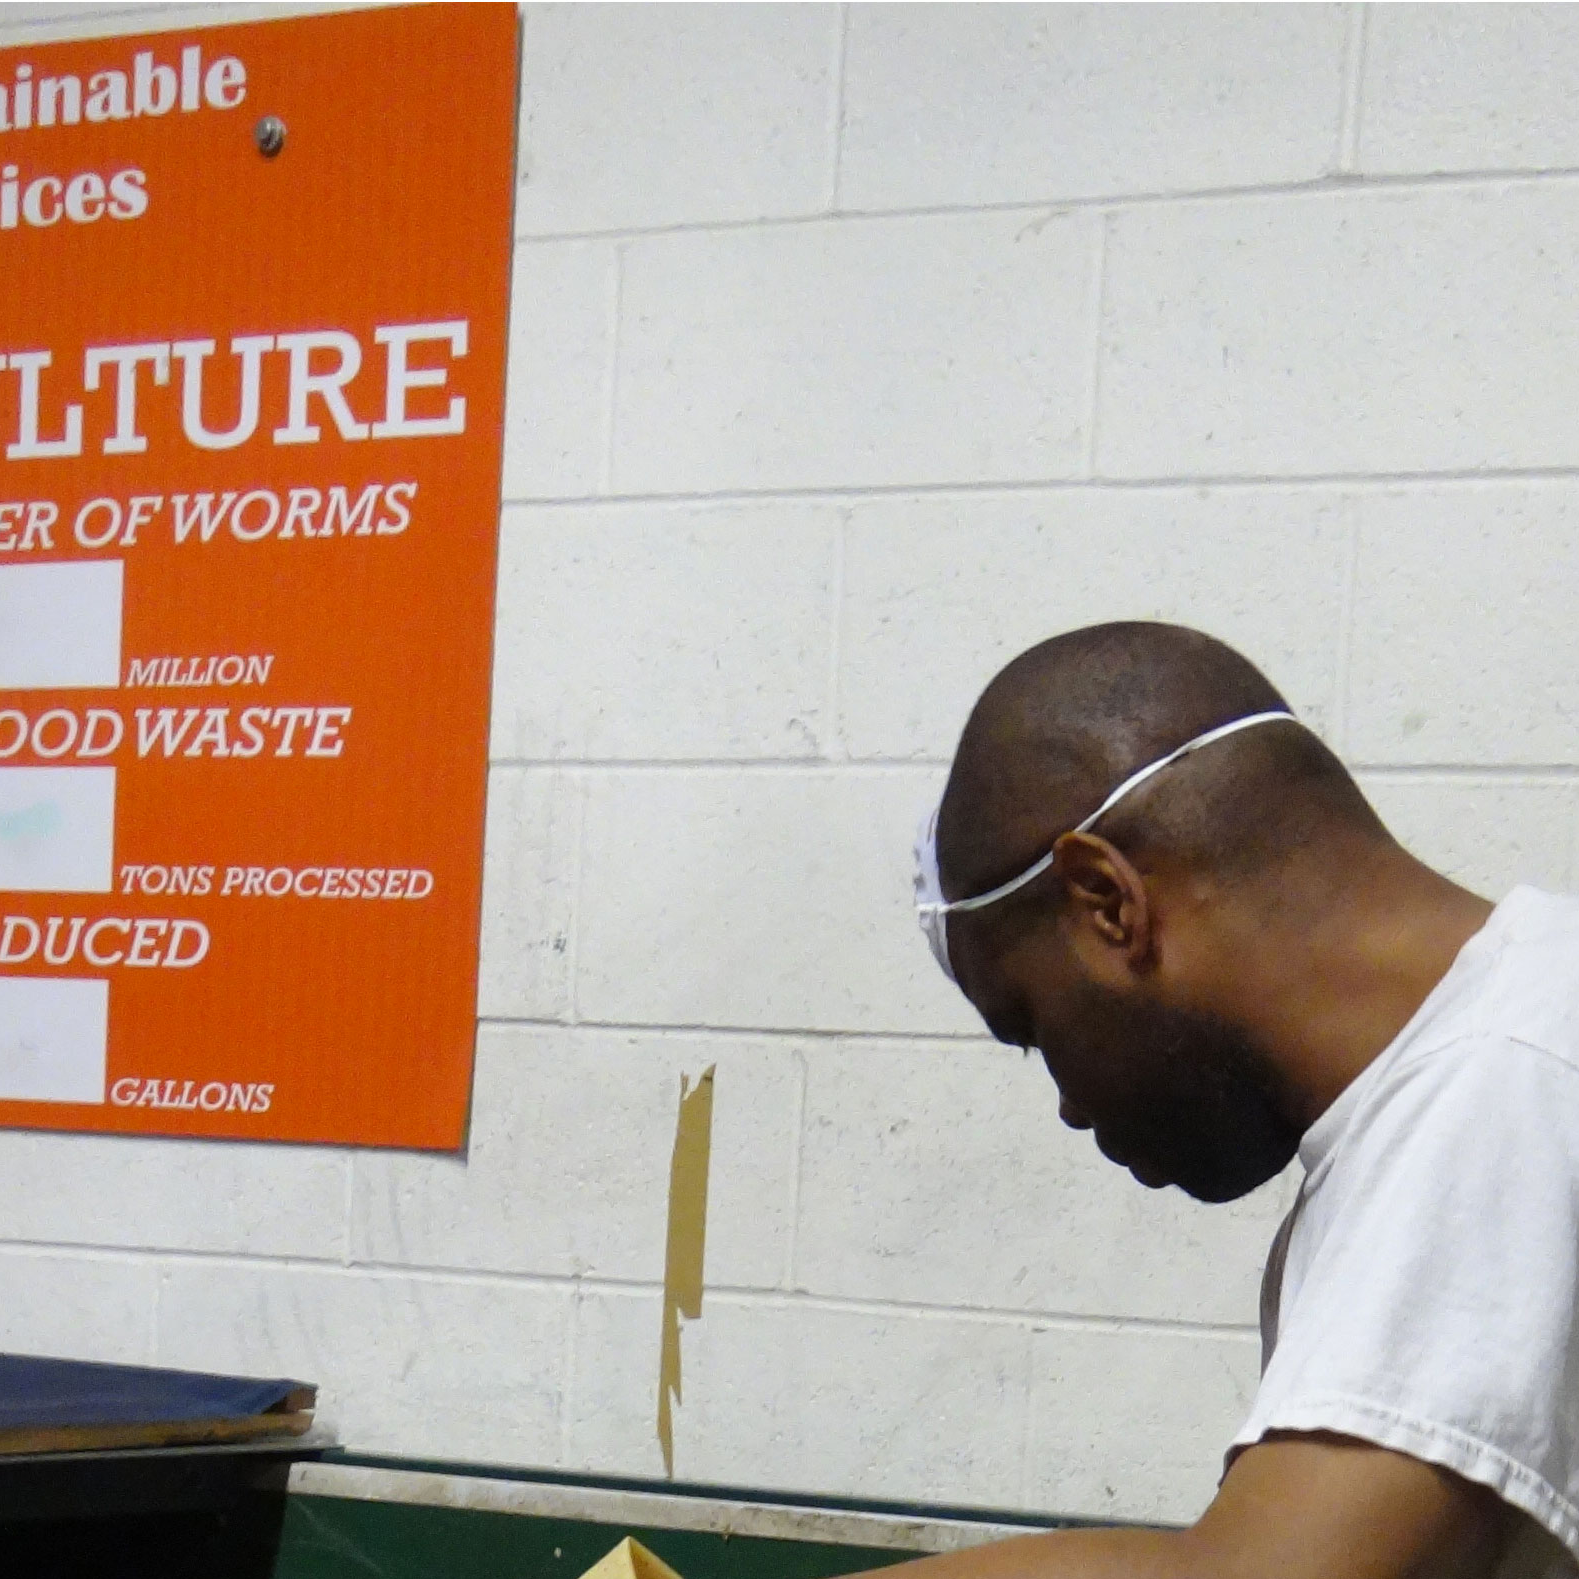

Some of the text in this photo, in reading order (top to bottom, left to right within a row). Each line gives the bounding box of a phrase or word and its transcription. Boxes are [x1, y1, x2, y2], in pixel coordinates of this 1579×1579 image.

[73, 494, 165, 548] OF
[170, 481, 418, 543] WORMS
[125, 654, 275, 688] MILLION
[134, 706, 352, 758] WASTE
[119, 864, 434, 899] TONS PROCESSED
[110, 1077, 275, 1112] GALLONS
